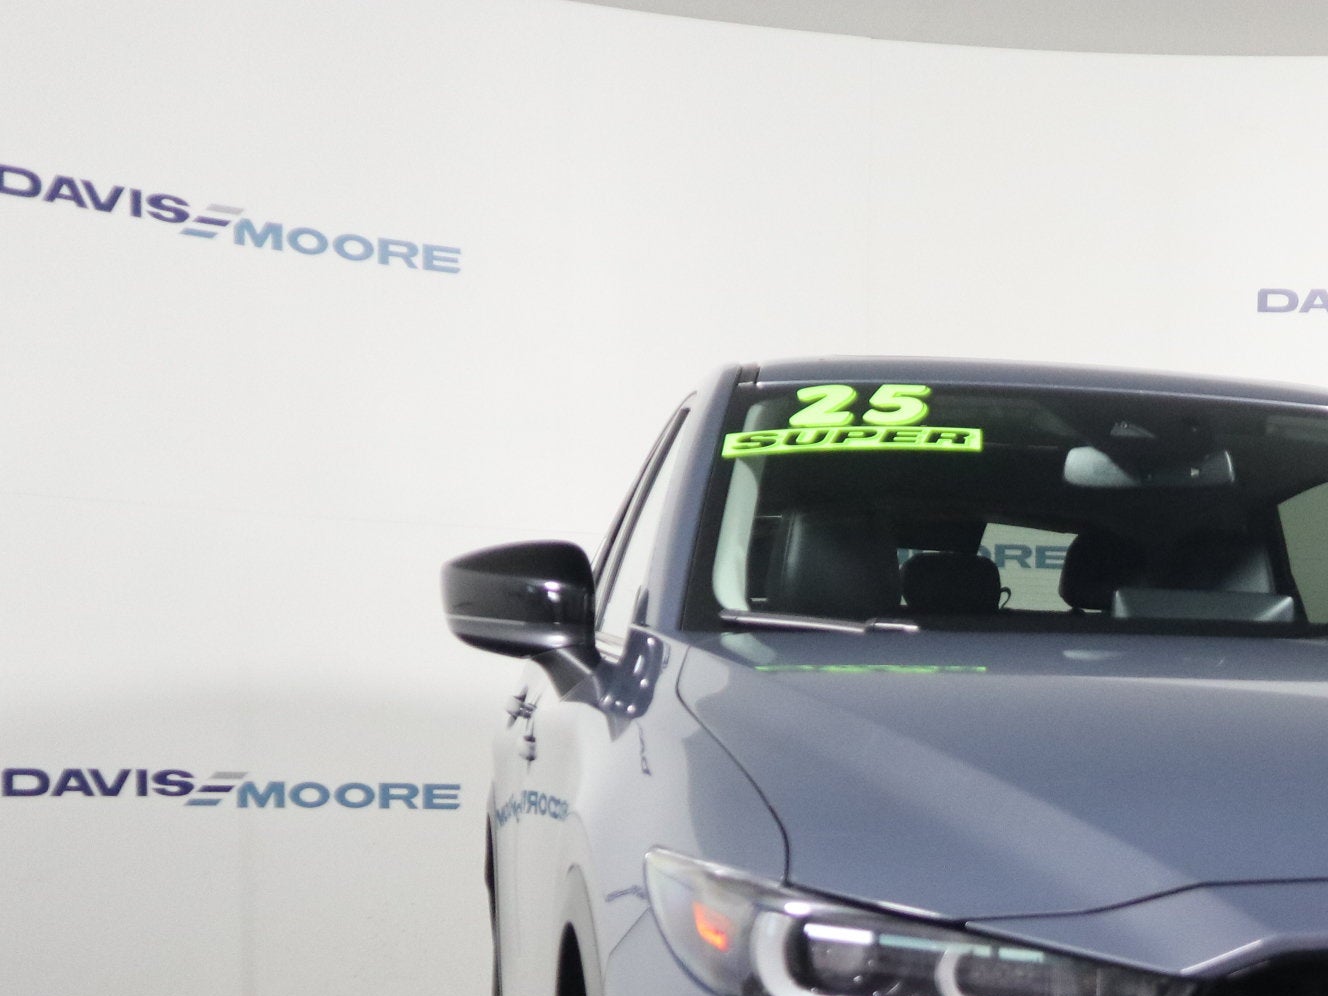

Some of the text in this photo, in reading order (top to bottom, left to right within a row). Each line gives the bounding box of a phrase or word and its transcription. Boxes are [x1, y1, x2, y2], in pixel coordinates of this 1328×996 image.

[0, 163, 462, 274] DAVIS MOORE
[788, 384, 933, 427] 25
[732, 427, 972, 451] SUPER
[0, 767, 196, 798] DAVIS
[236, 781, 462, 811] MOORE
